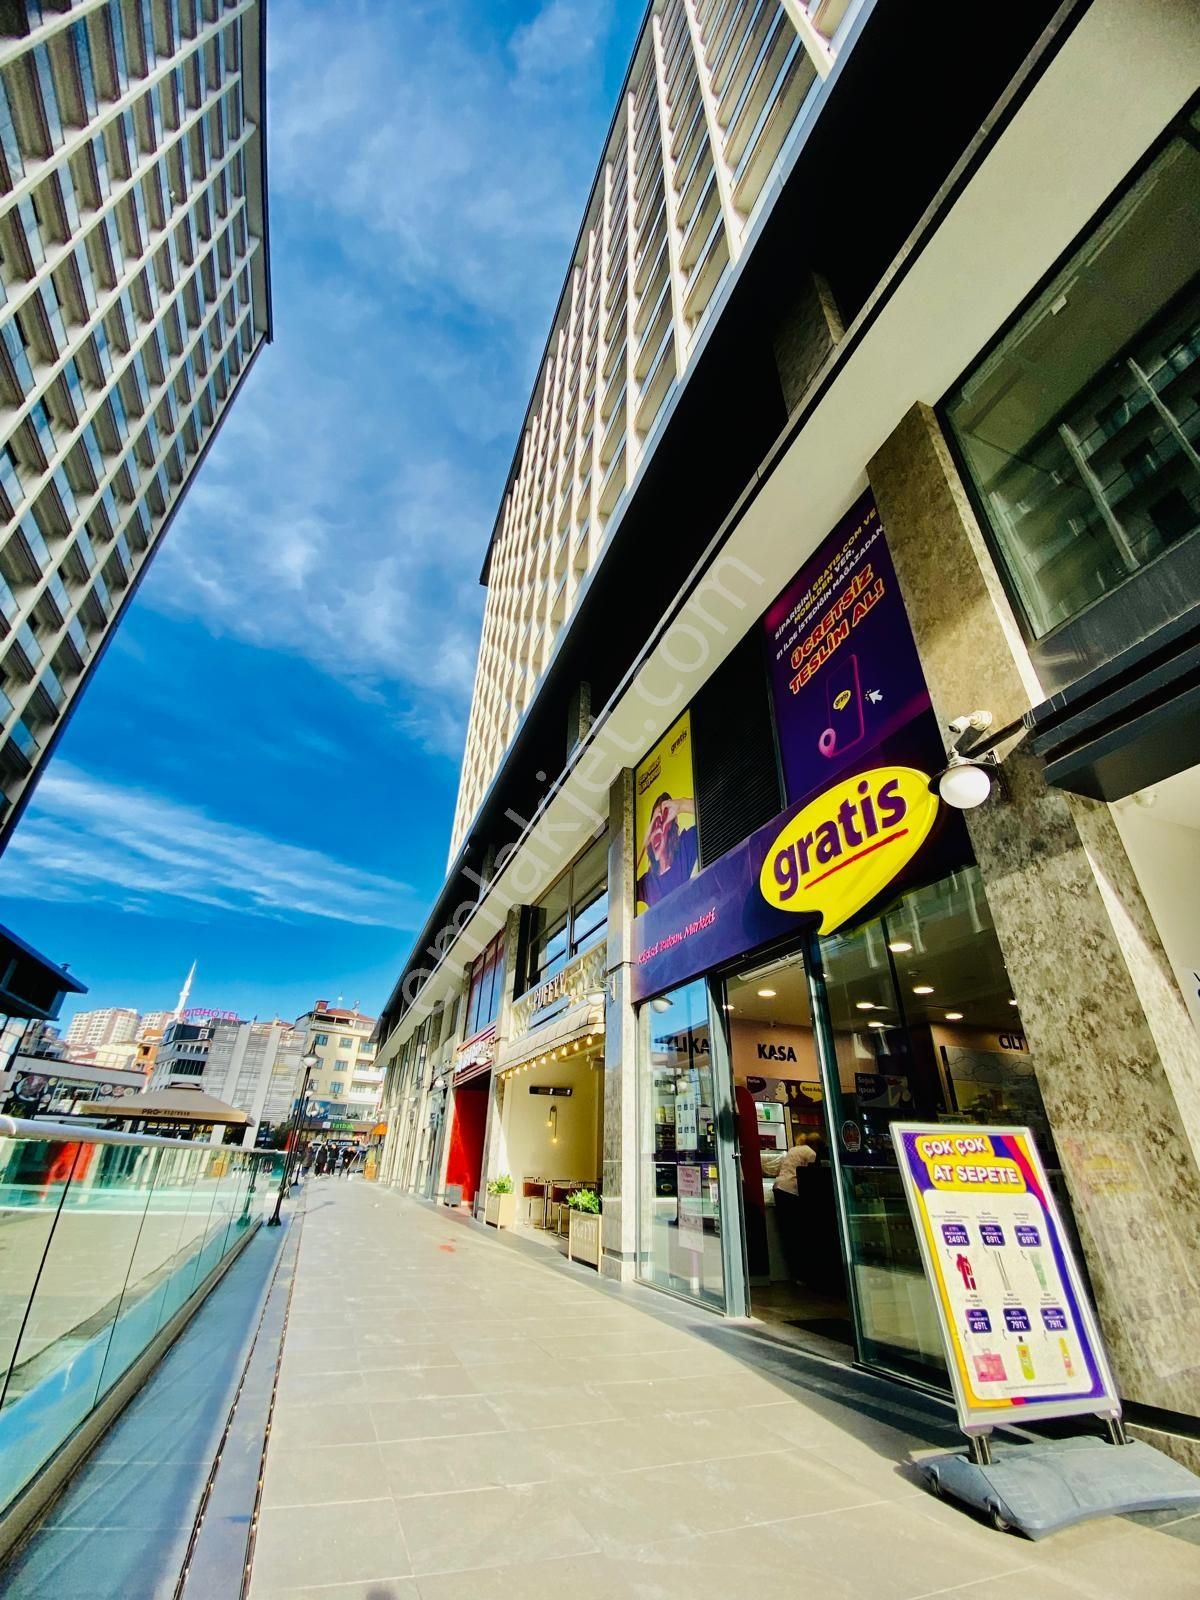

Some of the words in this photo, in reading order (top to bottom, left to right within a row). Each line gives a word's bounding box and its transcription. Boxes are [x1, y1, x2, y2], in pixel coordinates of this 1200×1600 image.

[863, 507, 877, 526] VE
[791, 563, 874, 669] ÜCRETSİZ
[789, 618, 850, 695] TESLİM
[851, 577, 885, 628] AL!
[773, 778, 908, 901] gratis
[757, 1043, 798, 1063] KASA
[922, 1140, 954, 1158] ÇOK
[955, 1138, 988, 1156] ÇOK
[933, 1164, 953, 1181] AT
[956, 1165, 1020, 1184] SEPETE
